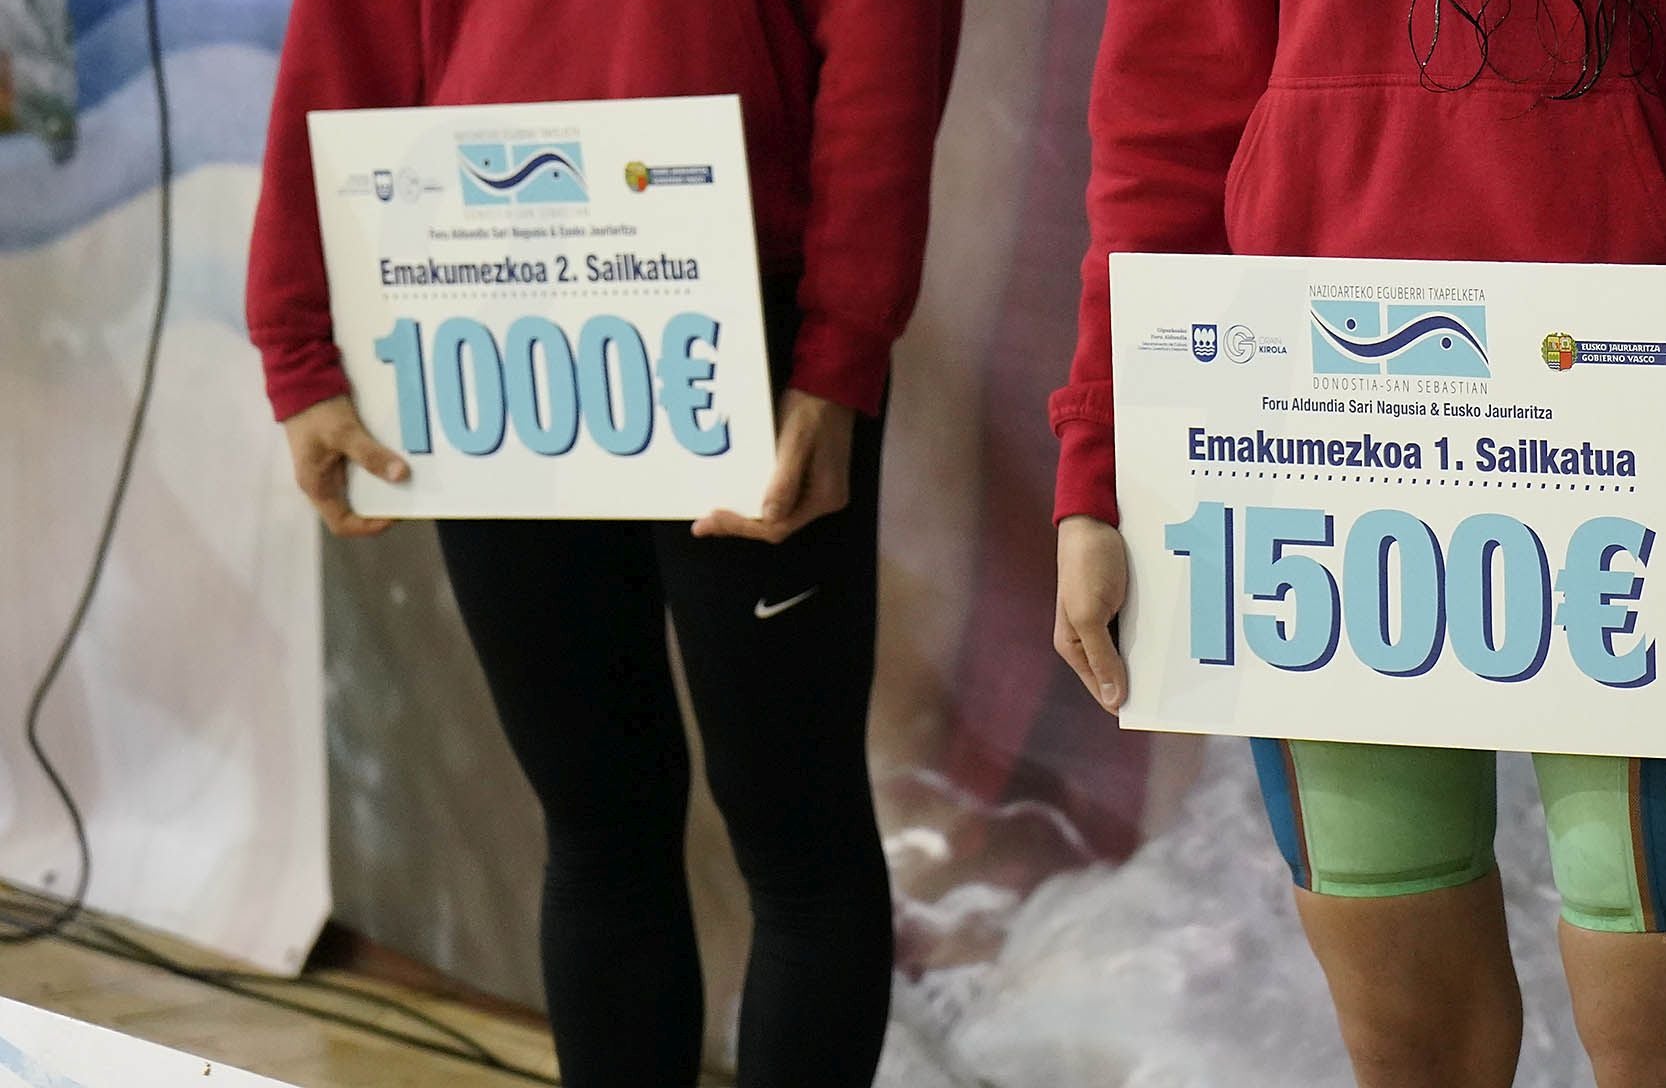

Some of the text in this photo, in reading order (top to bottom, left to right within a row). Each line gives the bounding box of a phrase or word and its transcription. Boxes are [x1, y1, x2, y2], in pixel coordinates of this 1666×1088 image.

[380, 253, 699, 286] Emakumezkoa 2. Sailkatua
[1309, 284, 1486, 302] NAZIOARTEKO EGUBERRI TXAPELKETA
[1258, 345, 1288, 354] KIROLA
[1581, 343, 1661, 353] EUSKO JAURLARITZA
[1581, 353, 1656, 364] GOBIERNO VASCO
[373, 312, 731, 458] 1000€
[1312, 377, 1488, 395] DONOSTIA-SAN SEBASTIAN
[1262, 396, 1553, 420] Foru Aldundia Sari Nagusia & Eusko Jaurlaritza
[1188, 426, 1637, 478] Emakumezkoa 1. Sailkatua
[1164, 500, 1657, 689] 1500€
